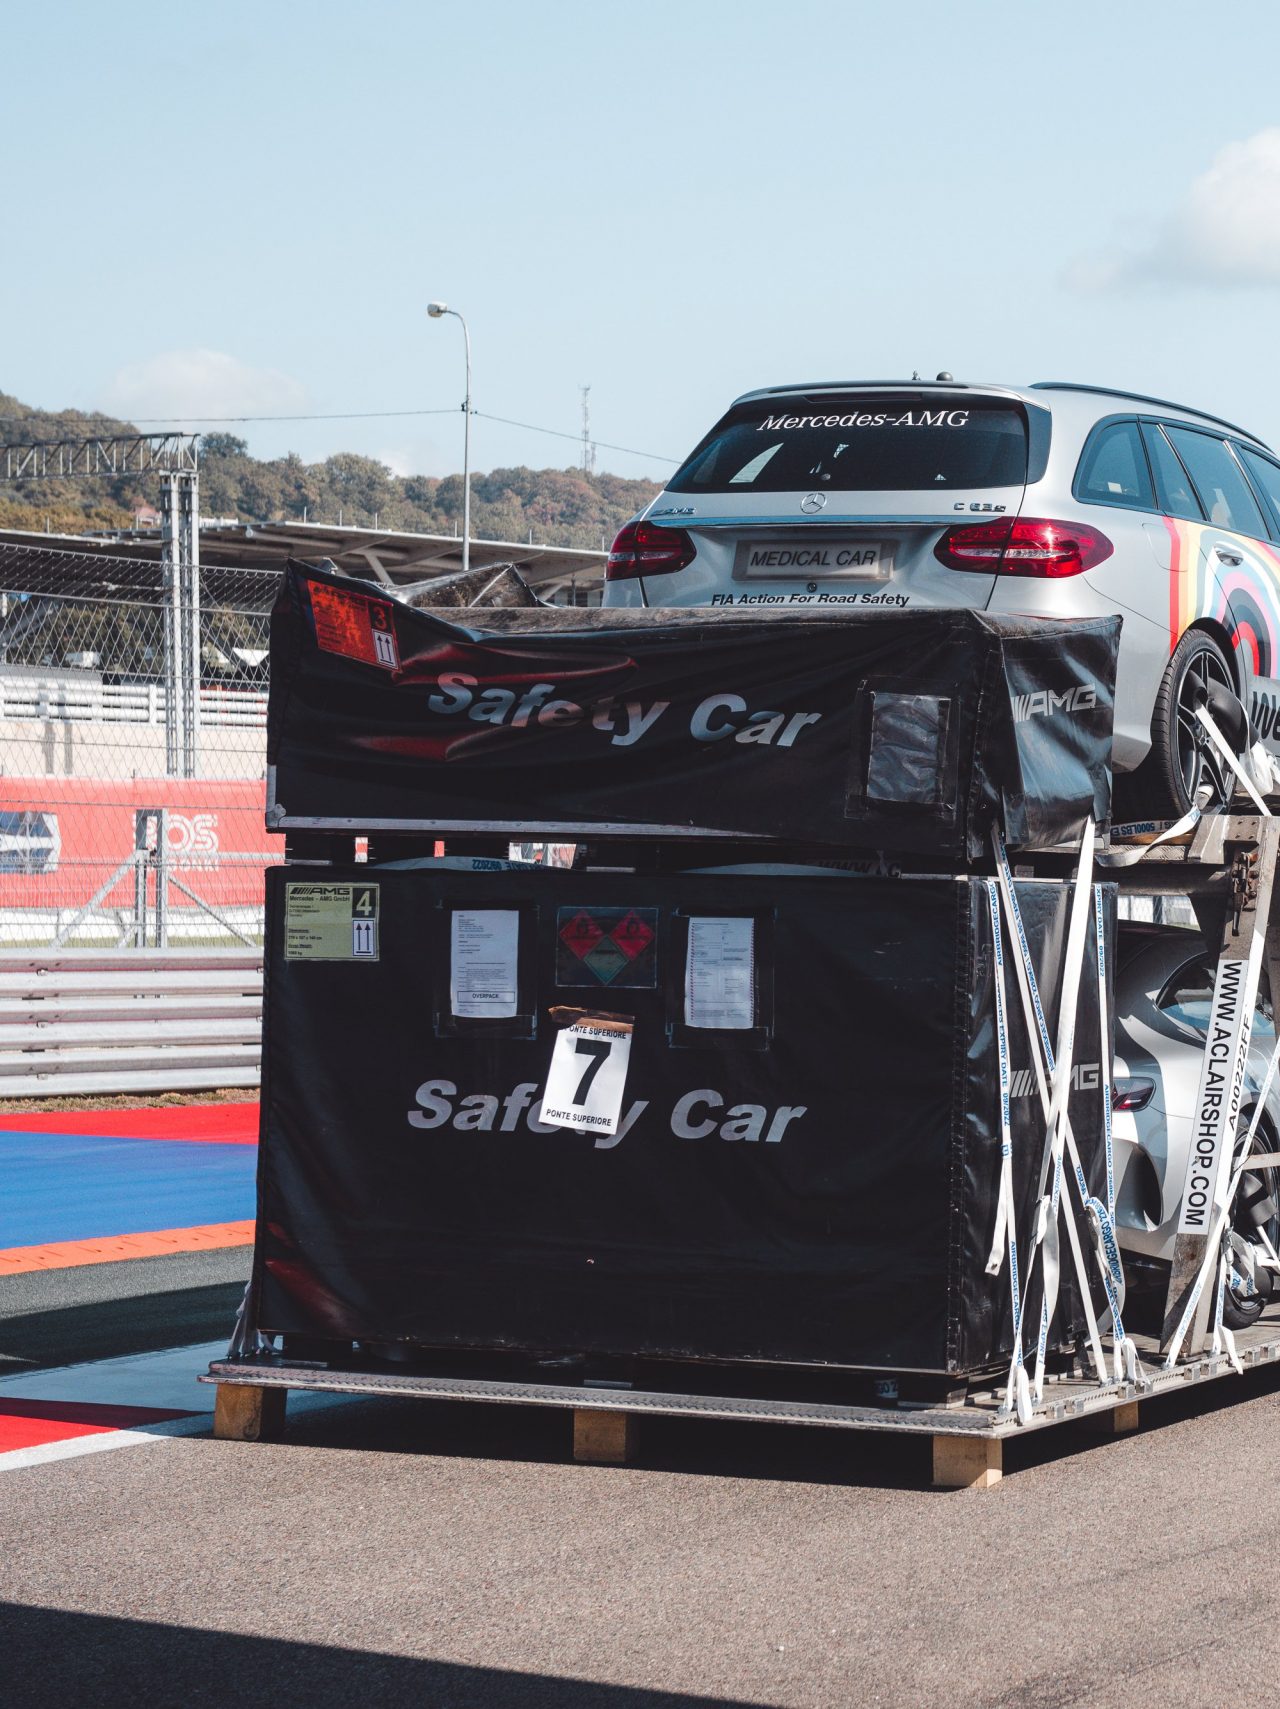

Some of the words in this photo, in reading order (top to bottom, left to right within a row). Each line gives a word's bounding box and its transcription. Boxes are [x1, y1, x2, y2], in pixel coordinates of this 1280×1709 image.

[756, 410, 970, 431] Mercedes-AMG
[953, 502, 965, 510] C
[750, 550, 831, 566] MEDICAL
[836, 550, 877, 566] CAR
[711, 594, 734, 606] FIA
[737, 594, 787, 605] Action
[789, 594, 816, 604] For
[817, 594, 858, 605] Road
[860, 594, 910, 608] Safety
[373, 605, 388, 630] 3
[427, 671, 669, 747] Safety
[690, 693, 823, 748] Car
[1025, 684, 1097, 720] AMG
[311, 887, 350, 896] AMG
[356, 890, 373, 916] 4
[565, 1025, 588, 1035] ONTE
[588, 1027, 627, 1040] SUPERIORE
[572, 1037, 612, 1107] 7
[1228, 1017, 1250, 1131] A00222FF
[1185, 961, 1243, 1226] WWW.ACLAIRSHOP.COM
[407, 1078, 650, 1149] Safy
[669, 1088, 808, 1143] Car
[545, 1108, 571, 1122] PONTE
[572, 1113, 612, 1127] SUPERIORE
[1104, 1084, 1113, 1169] AIRBRIDGECARGO
